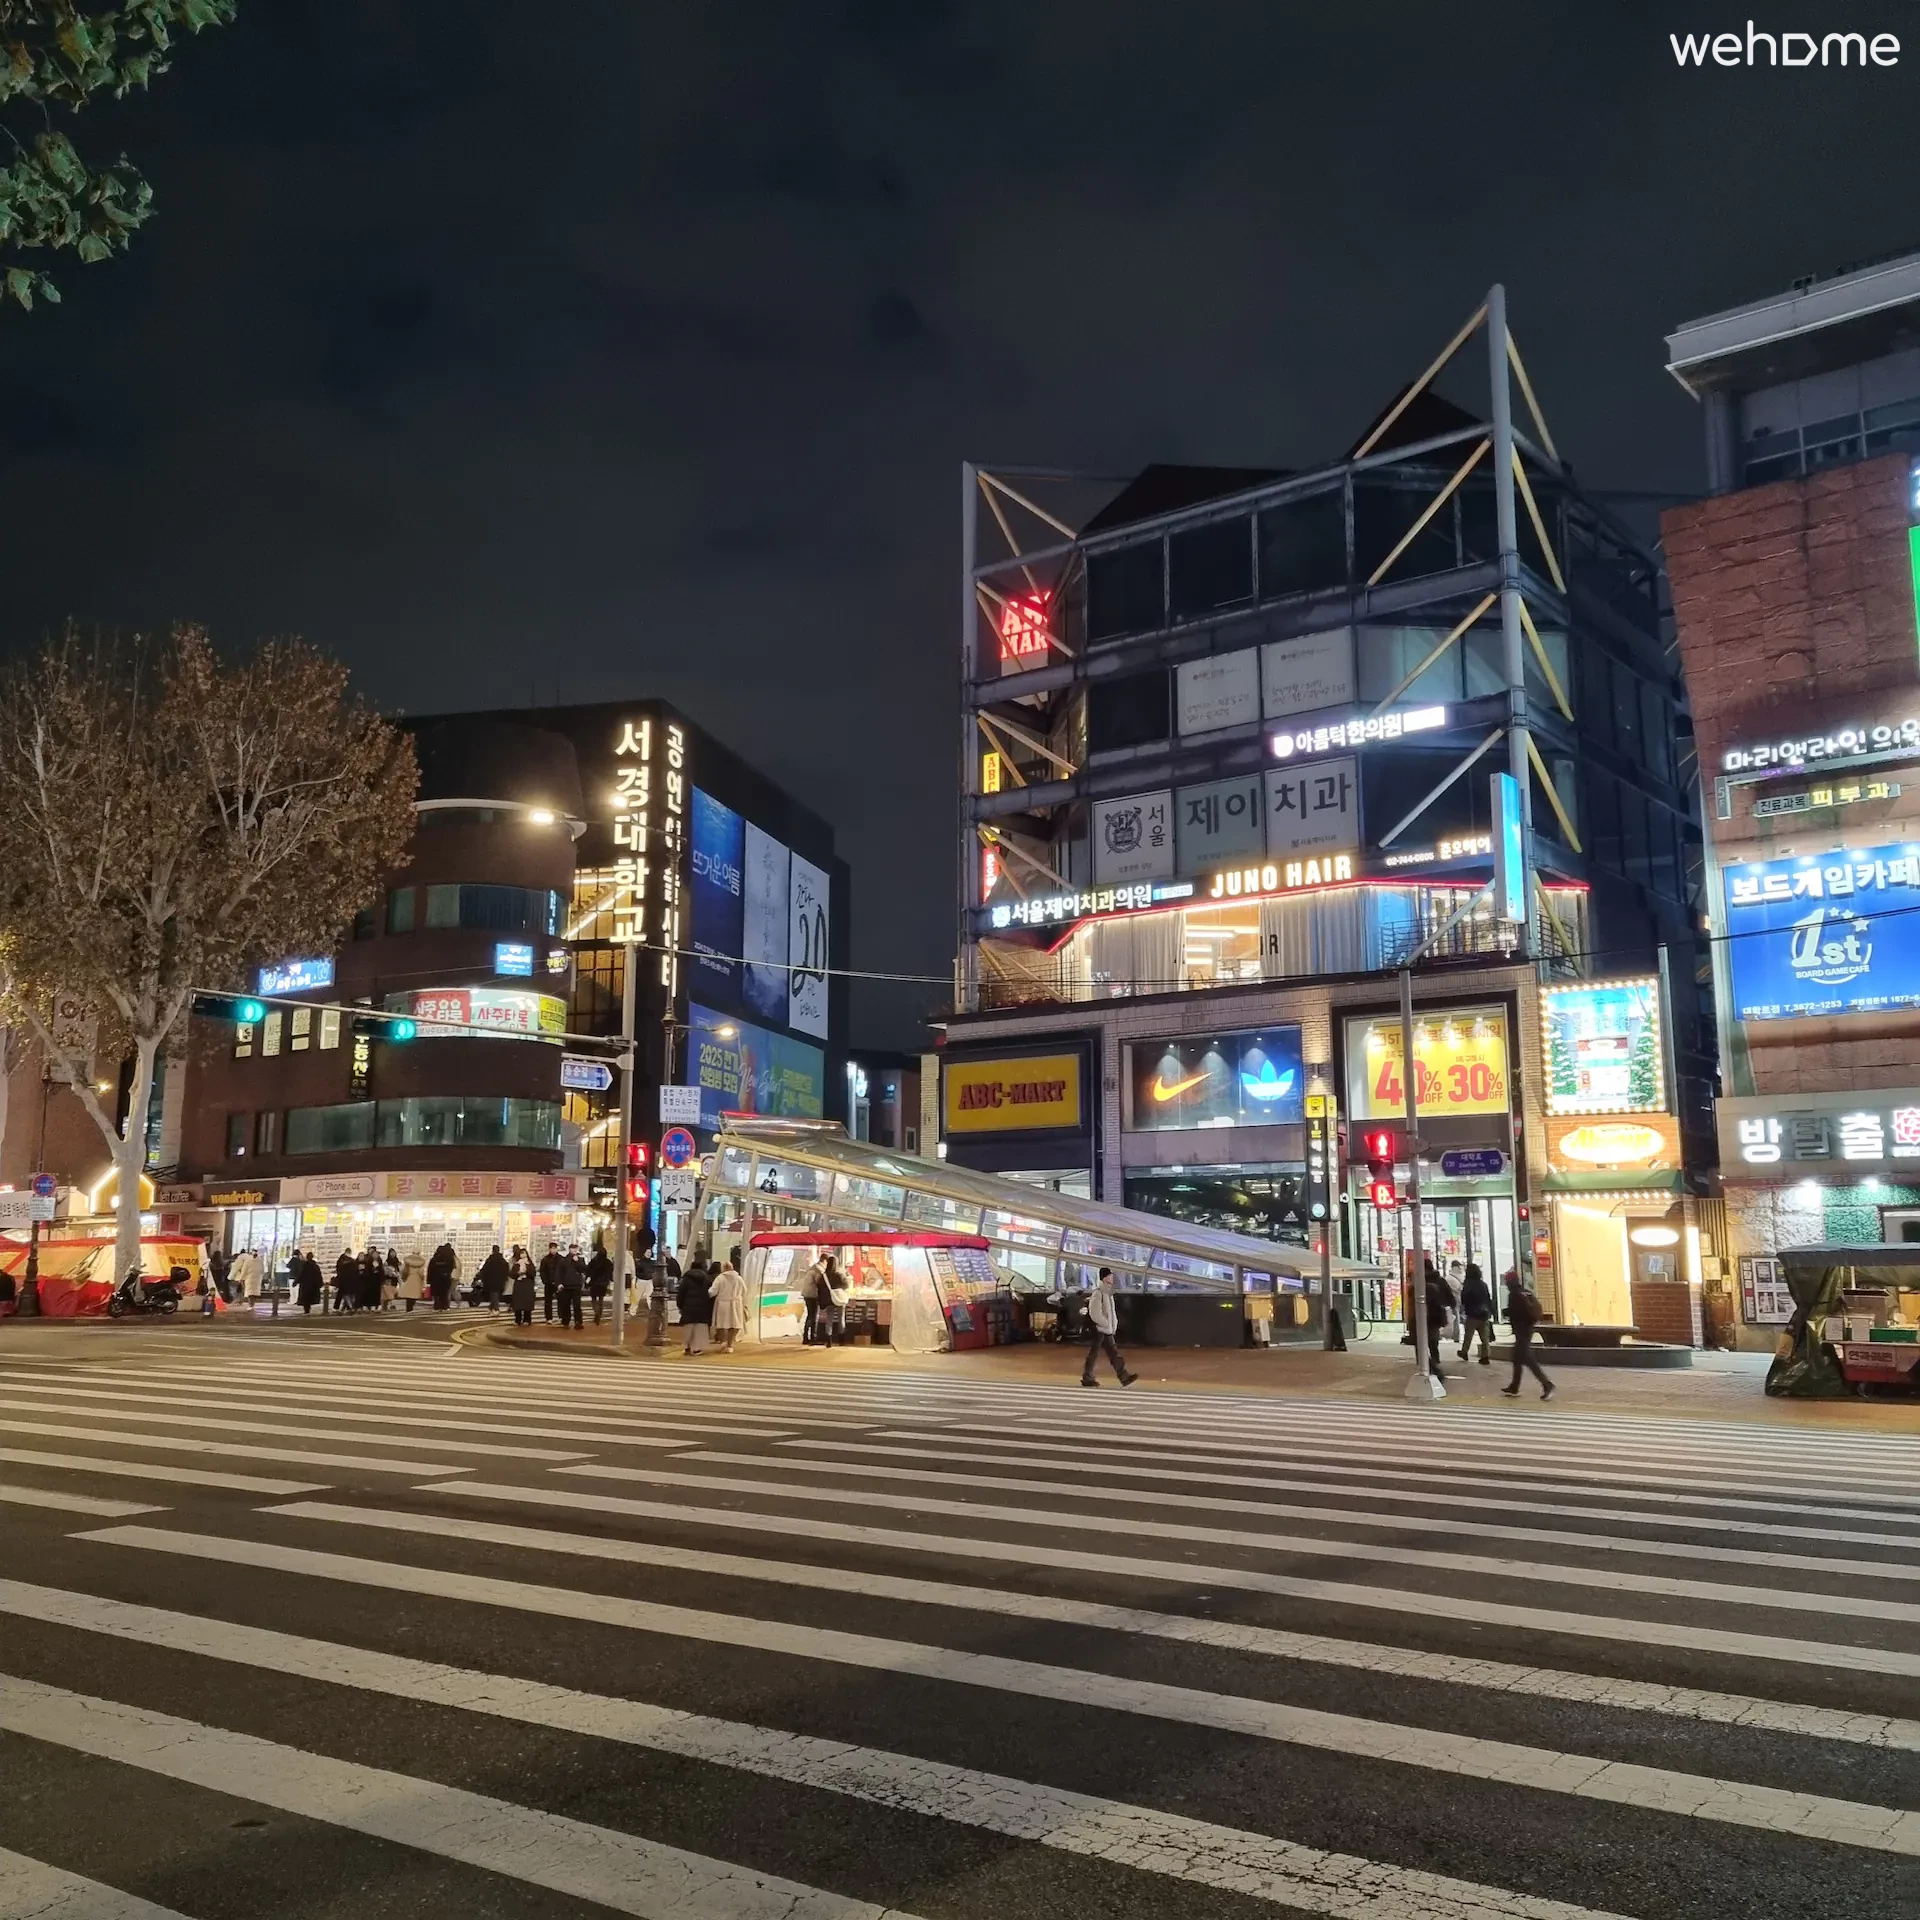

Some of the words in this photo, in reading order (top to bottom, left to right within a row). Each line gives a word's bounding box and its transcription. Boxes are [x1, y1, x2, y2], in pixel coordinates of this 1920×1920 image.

[1296, 713, 1402, 752] 아름턱한의원
[1186, 788, 1258, 835] 제이
[1275, 773, 1352, 820] 치과
[1760, 795, 1806, 814] 진료과목
[1811, 782, 1891, 806] 피부과
[609, 720, 650, 943] 서경대학교
[1149, 804, 1166, 847] 서울
[692, 850, 721, 886] 뜨거운
[722, 863, 741, 897] 여름
[1211, 866, 1278, 899] JUNO
[1287, 855, 1351, 888] HAIR
[1732, 856, 1920, 905] 보드게임카페
[1012, 885, 1152, 924] 서울제이치과의원
[1796, 970, 1824, 979] BOARD
[1825, 967, 1849, 977] GAME
[1849, 964, 1870, 974] CAFE
[477, 1007, 528, 1024] 사주타로
[958, 1081, 1066, 1110] ABC-MART
[1425, 1092, 1443, 1104] OFF
[1448, 1062, 1503, 1103] 30%
[1489, 1090, 1504, 1100] OFF
[1739, 1113, 1884, 1163] 방탈출
[211, 1190, 264, 1205] wonderbra
[663, 1174, 694, 1185] 견인지역
